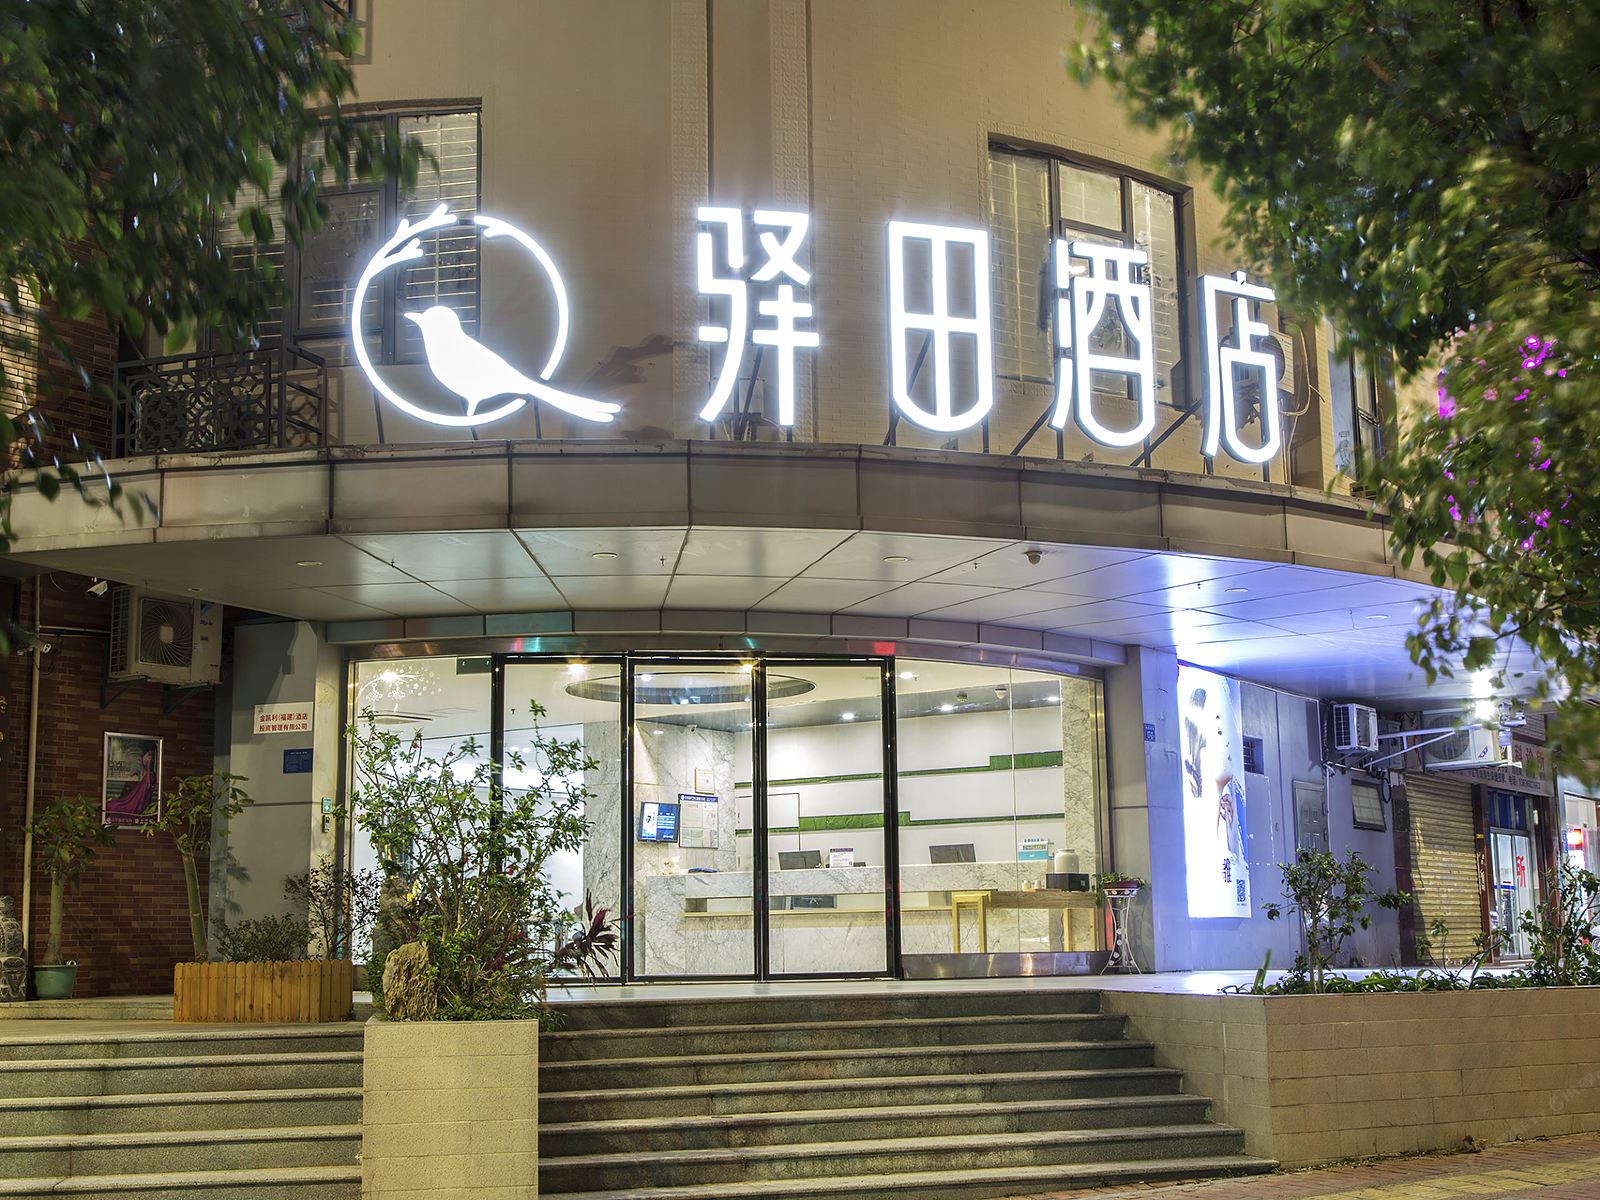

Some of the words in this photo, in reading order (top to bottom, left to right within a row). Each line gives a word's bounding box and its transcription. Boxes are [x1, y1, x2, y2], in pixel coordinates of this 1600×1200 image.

[697, 206, 1281, 465] 驿田酒店
[259, 723, 308, 732] 投资管理有限公司
